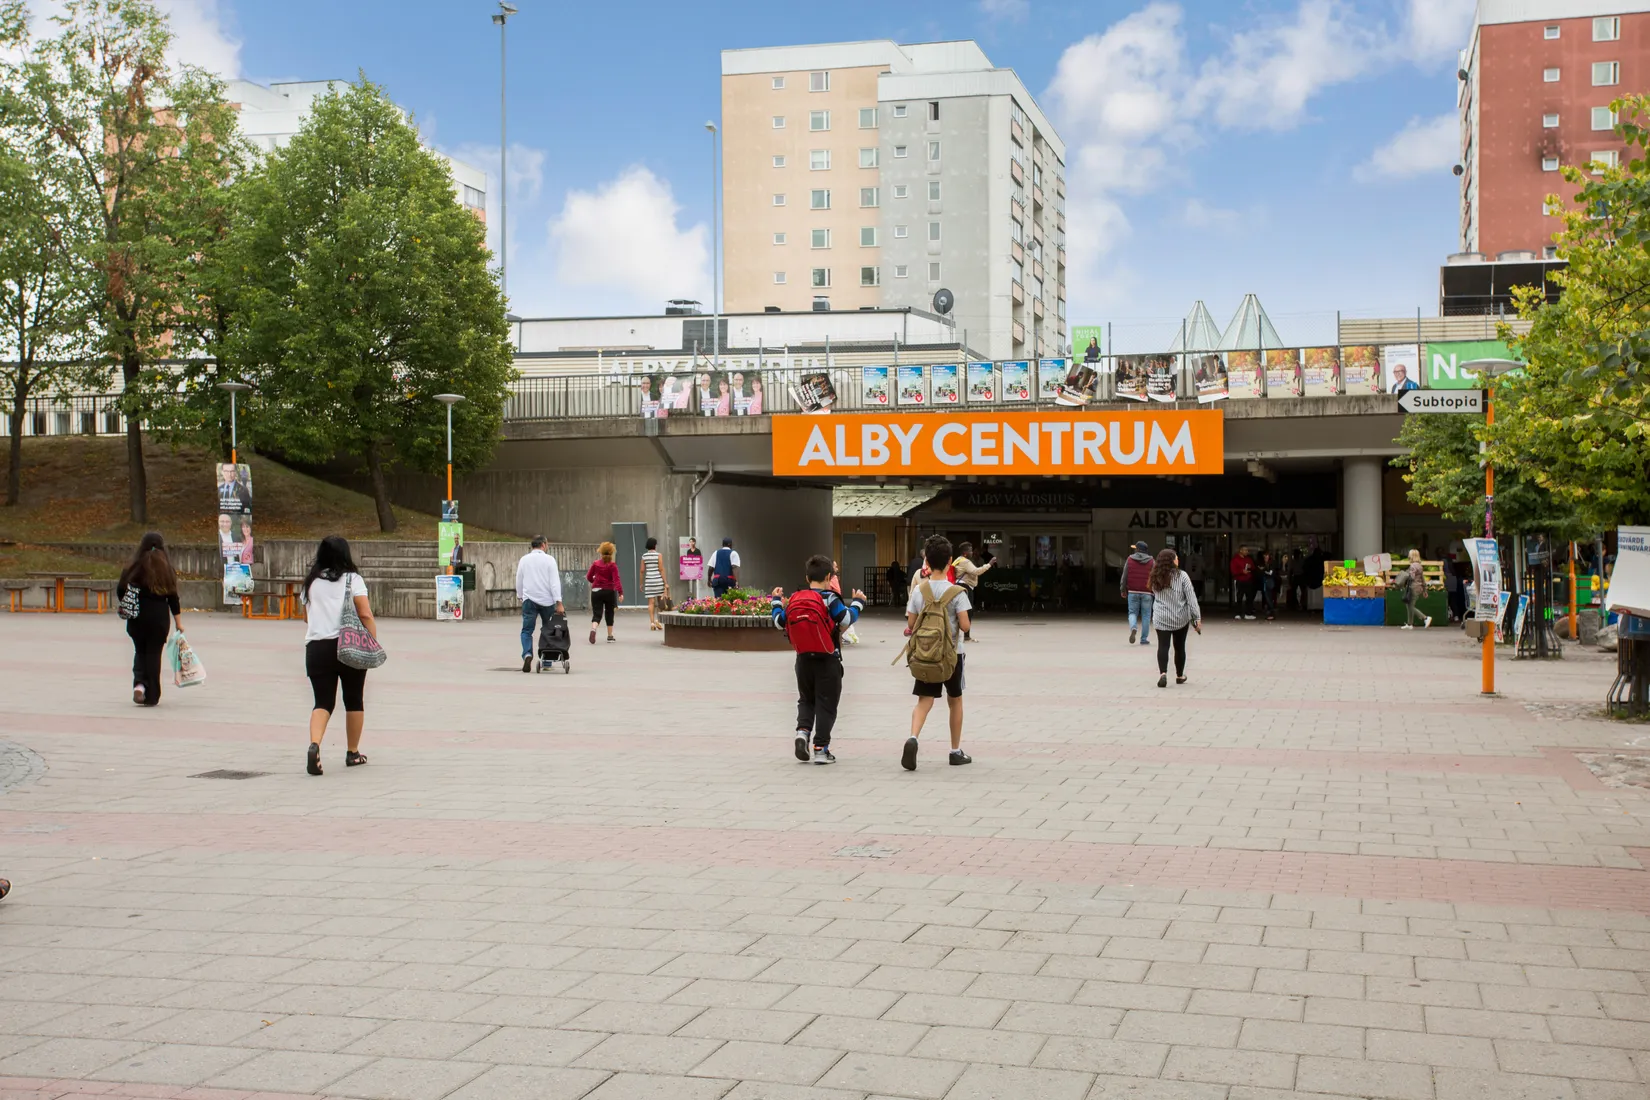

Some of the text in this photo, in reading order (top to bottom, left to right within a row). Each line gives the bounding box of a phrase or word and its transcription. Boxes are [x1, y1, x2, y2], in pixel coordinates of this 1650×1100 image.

[1413, 396, 1477, 409] Subtopia
[798, 420, 1195, 466] ALBY CENTRUM
[967, 493, 1002, 505] ALBY
[1128, 510, 1298, 529] ALBY CENTRUM
[1372, 554, 1382, 571] 9
[992, 582, 1018, 590] Sweden
